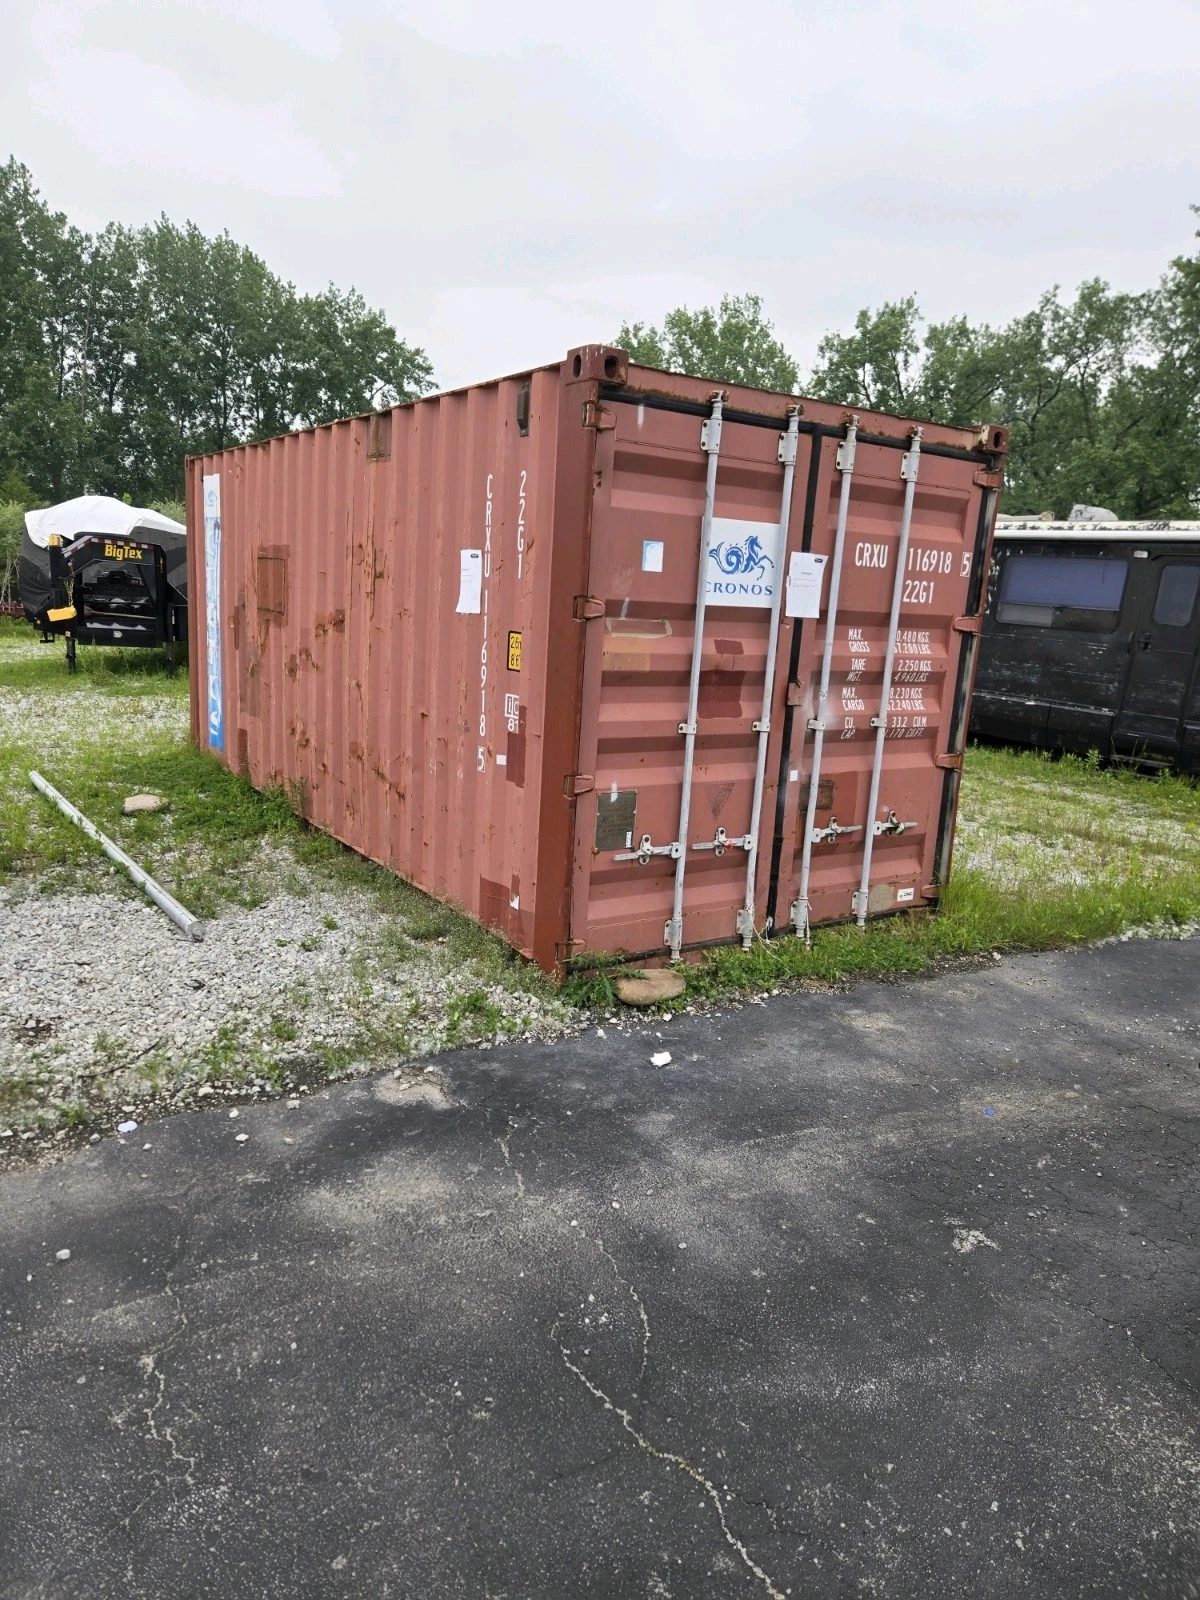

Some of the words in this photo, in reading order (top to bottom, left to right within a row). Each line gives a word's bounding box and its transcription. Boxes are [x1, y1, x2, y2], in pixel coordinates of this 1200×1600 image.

[484, 473, 493, 578] CRXU
[517, 470, 527, 579] 22G1
[104, 544, 143, 561] BigTex
[855, 542, 889, 569] CRXU
[908, 547, 953, 574] 116918
[961, 552, 972, 576] 5
[705, 581, 773, 596] CRONOS
[902, 579, 935, 604] 22G1
[896, 630, 916, 643] 0.480
[849, 641, 871, 653] GROSS
[479, 590, 489, 737] 116918
[851, 658, 867, 671] TARE
[889, 687, 910, 699] 8.230
[842, 699, 865, 711] CARGO
[477, 746, 486, 772] 5
